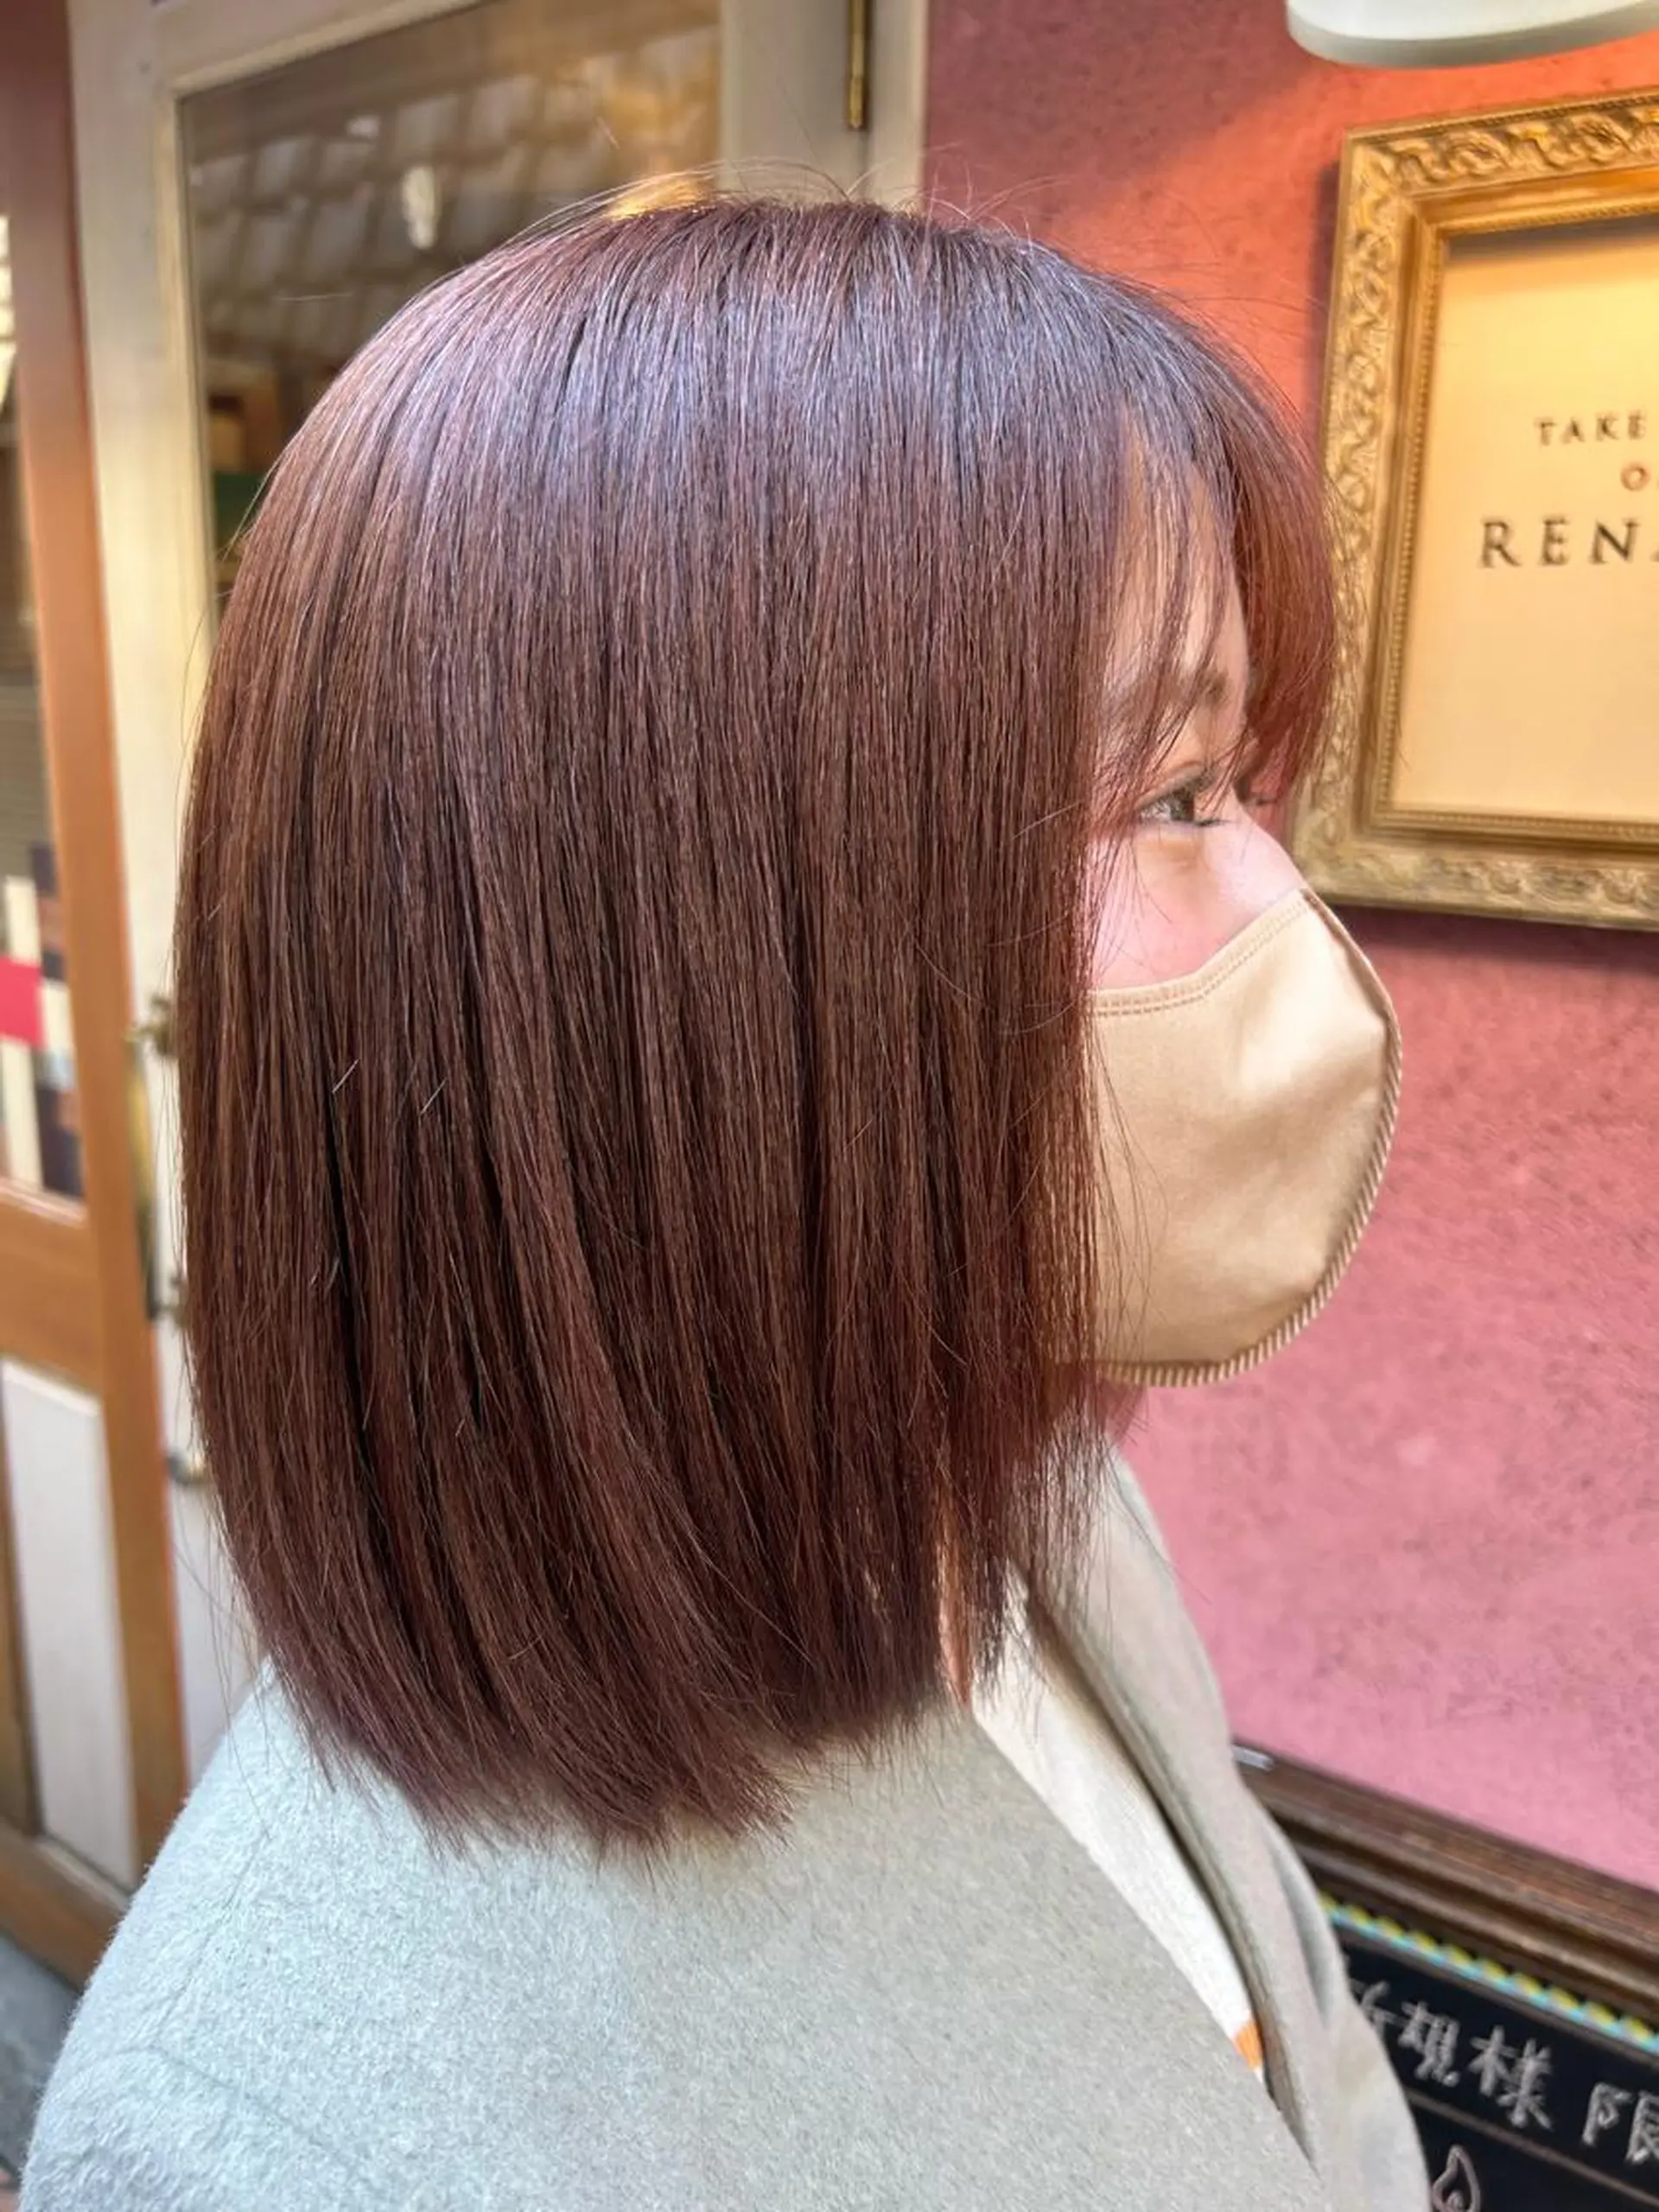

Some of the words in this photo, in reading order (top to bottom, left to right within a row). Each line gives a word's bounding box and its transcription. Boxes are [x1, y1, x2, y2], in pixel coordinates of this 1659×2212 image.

[1537, 412, 1645, 446] TAKE
[1619, 461, 1659, 492] O
[1479, 516, 1659, 568] REN
